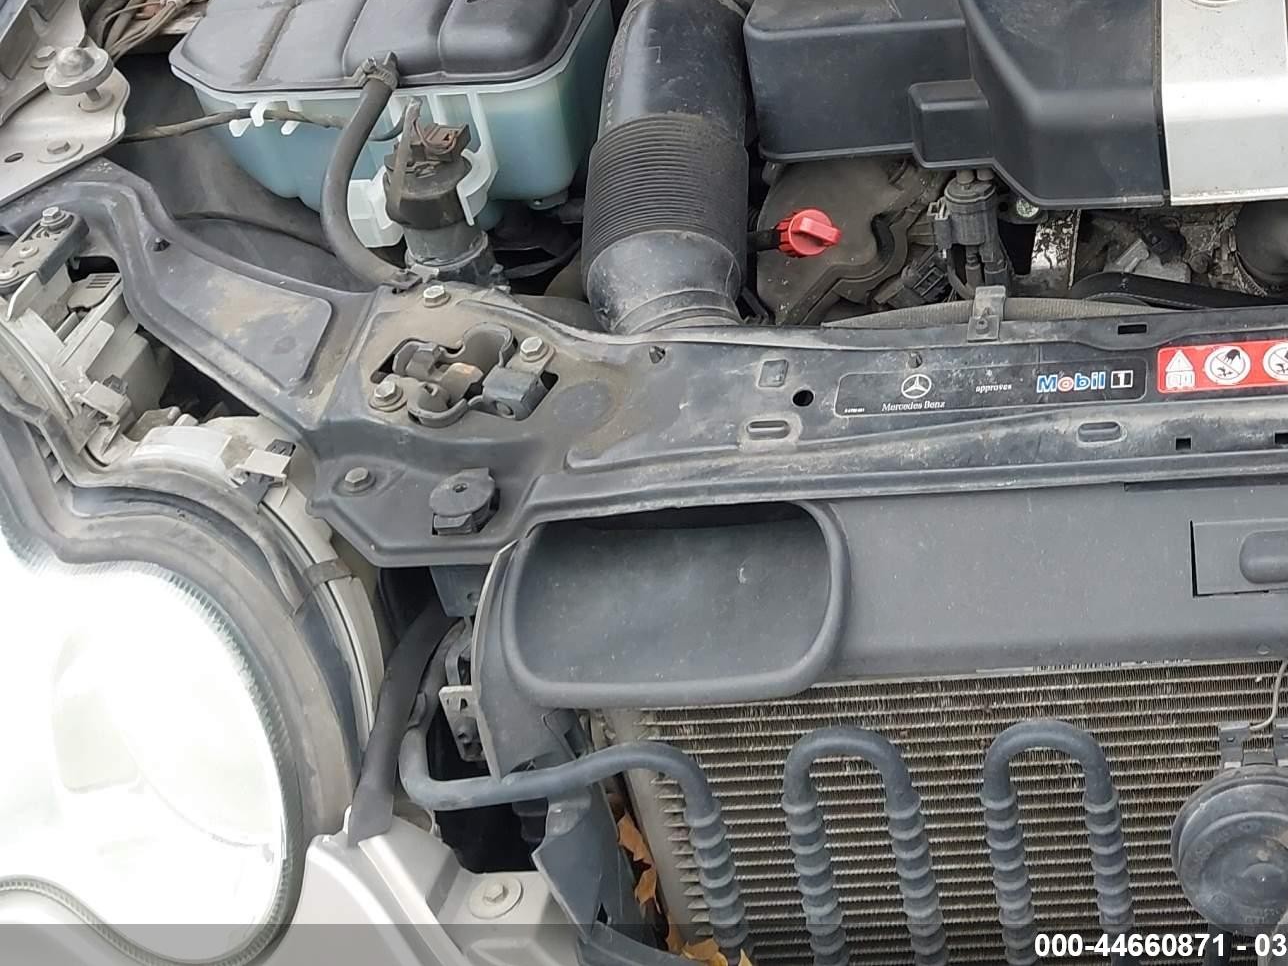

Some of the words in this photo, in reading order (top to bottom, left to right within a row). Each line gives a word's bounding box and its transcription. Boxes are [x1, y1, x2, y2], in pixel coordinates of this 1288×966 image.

[1037, 372, 1106, 393] Mobil
[975, 384, 1012, 393] approves
[882, 402, 922, 411] Mercedes
[924, 401, 945, 409] Benz
